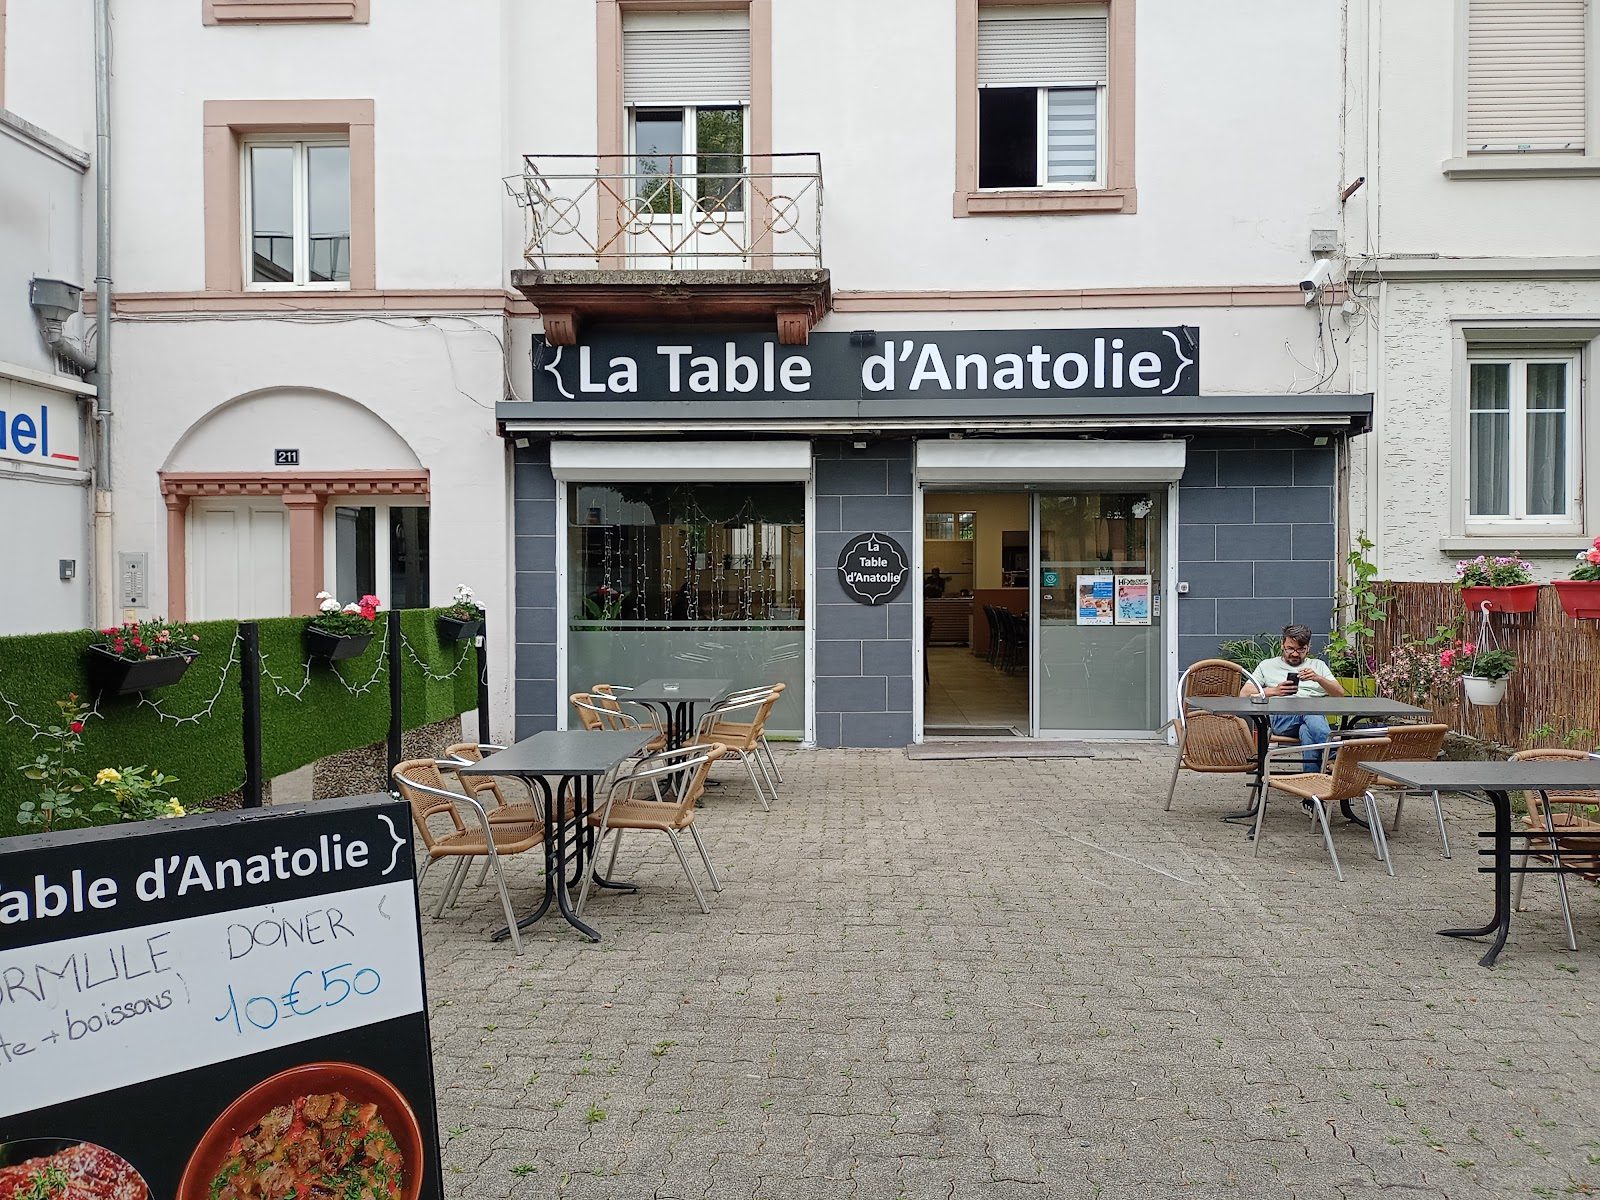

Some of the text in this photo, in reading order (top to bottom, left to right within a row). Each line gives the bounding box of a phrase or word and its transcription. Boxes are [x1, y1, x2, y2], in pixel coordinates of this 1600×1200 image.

[579, 337, 1163, 394] La Table d'Anatolie
[0, 404, 48, 458] el
[278, 451, 297, 463] 211
[859, 556, 888, 568] Table
[867, 542, 880, 552] La
[846, 571, 901, 583] d'Anatolie
[0, 833, 370, 925] able d'Anatolie
[0, 931, 171, 1004] RMULE
